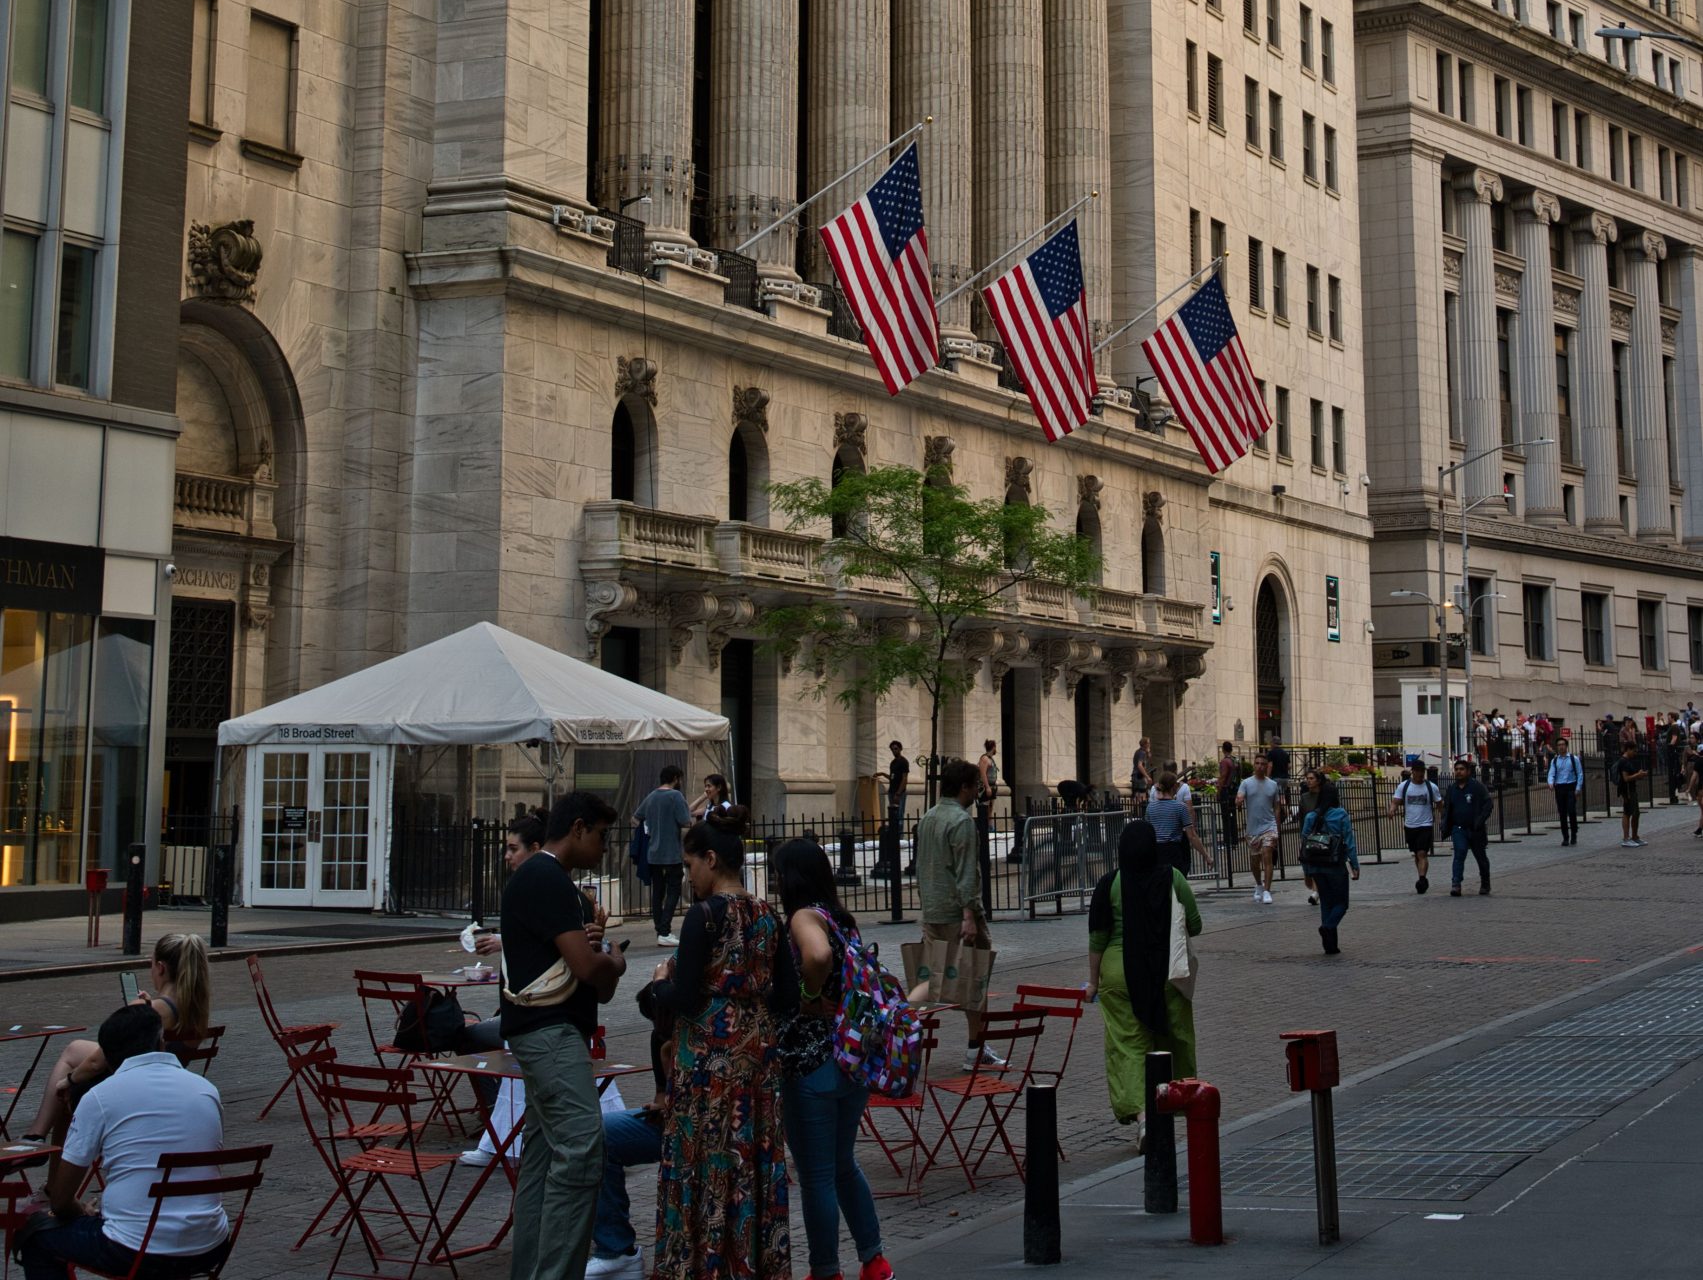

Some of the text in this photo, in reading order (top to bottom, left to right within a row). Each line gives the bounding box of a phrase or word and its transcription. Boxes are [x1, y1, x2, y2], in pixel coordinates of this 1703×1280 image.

[280, 727, 355, 739] 18 Broad Street
[580, 730, 625, 741] 18 Broad Street
